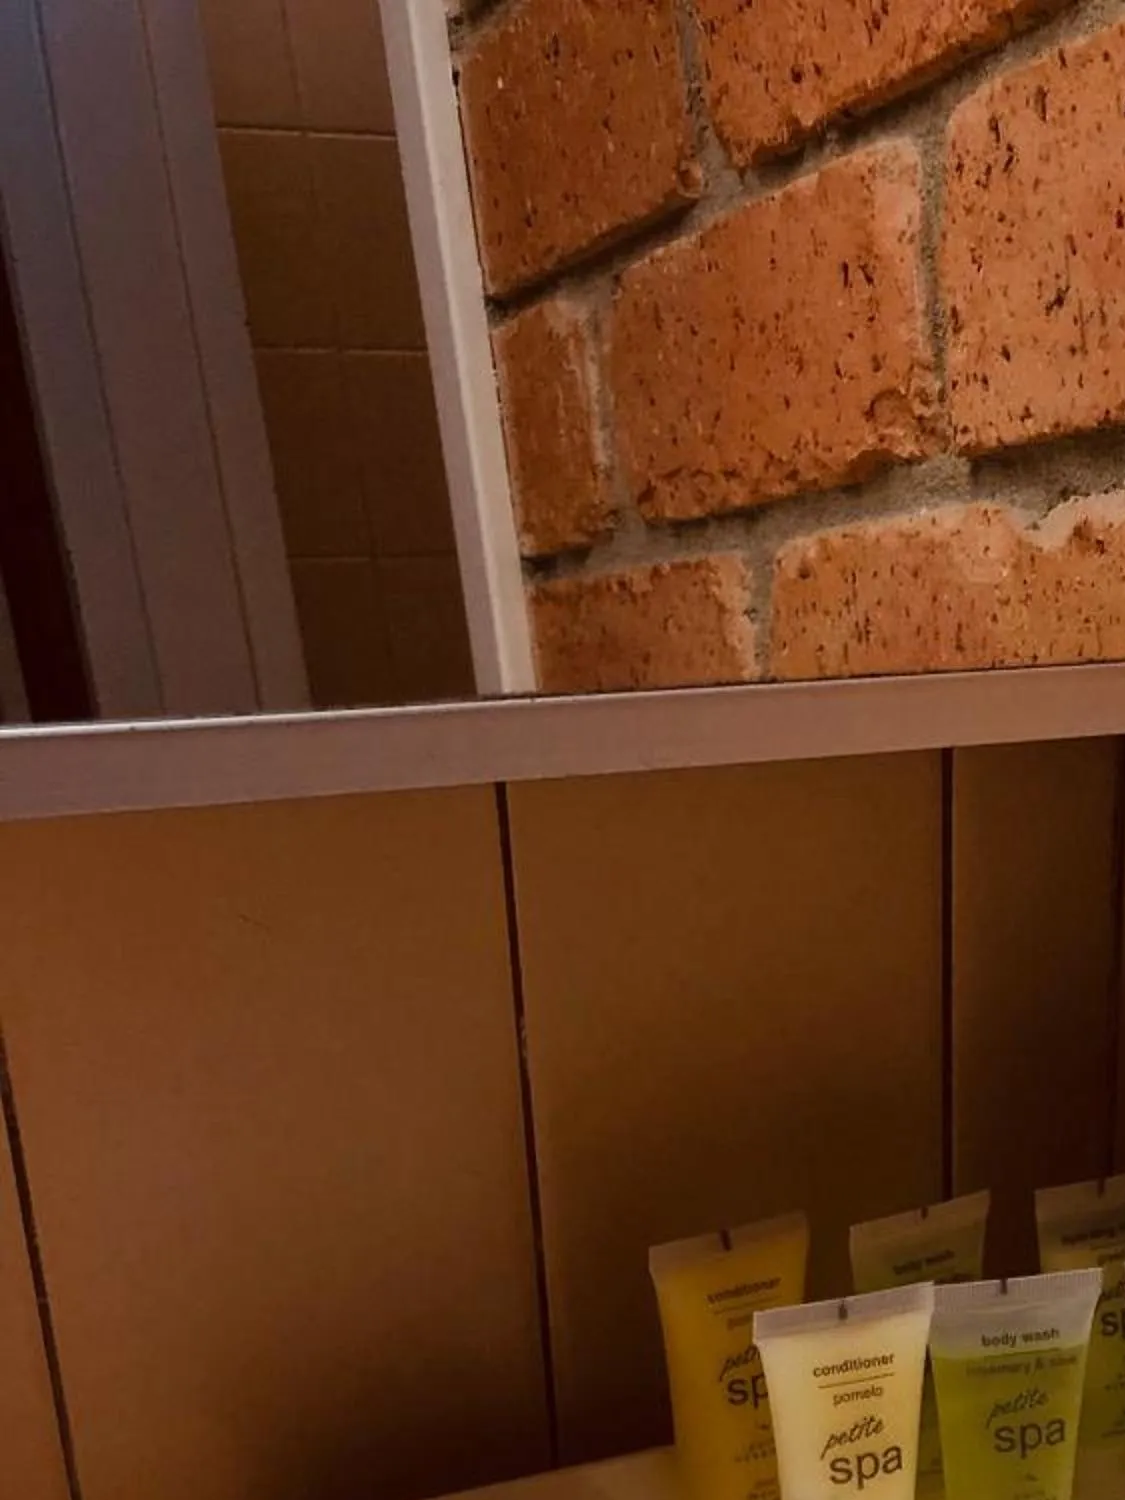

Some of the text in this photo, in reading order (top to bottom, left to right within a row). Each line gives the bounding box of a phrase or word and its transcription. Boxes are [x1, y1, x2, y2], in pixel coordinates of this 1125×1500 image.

[981, 1327, 1060, 1348] body wash
[813, 1353, 895, 1379] conditioner
[727, 1374, 769, 1409] sp
[833, 1385, 884, 1408] pomelo
[986, 1387, 1049, 1430] petite
[820, 1415, 885, 1461] petite
[994, 1417, 1066, 1460] spa
[829, 1445, 903, 1490] spa
